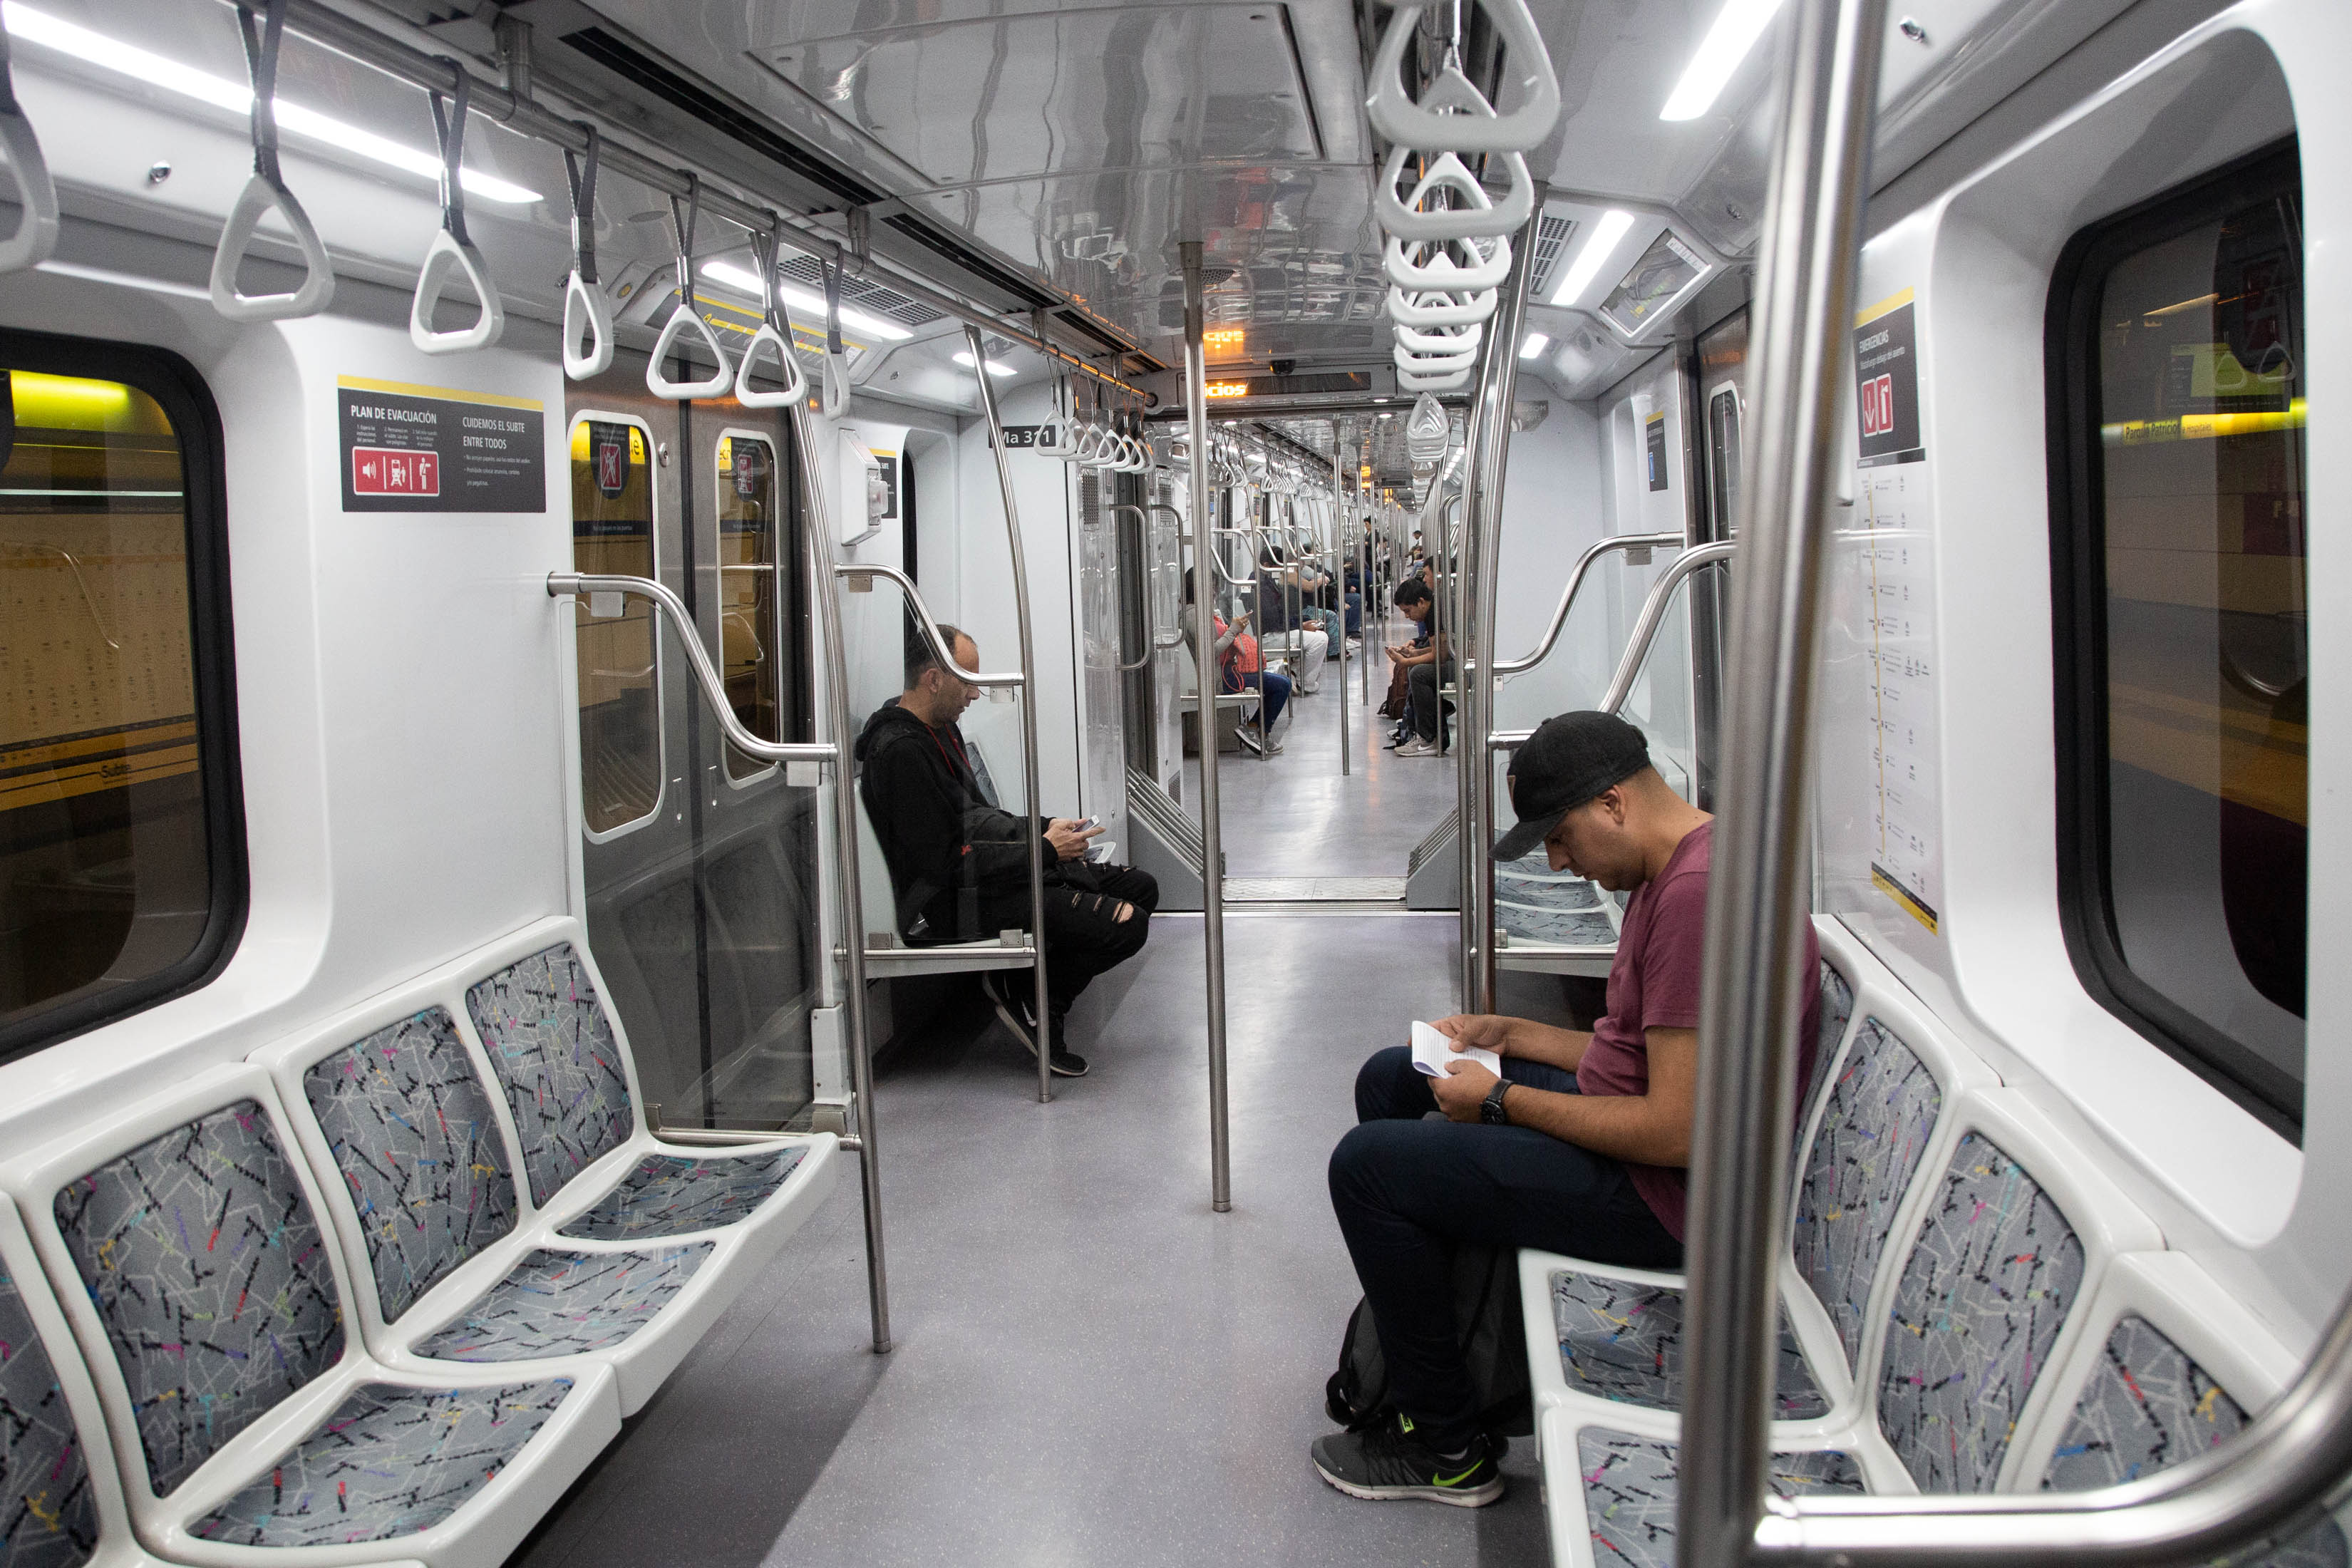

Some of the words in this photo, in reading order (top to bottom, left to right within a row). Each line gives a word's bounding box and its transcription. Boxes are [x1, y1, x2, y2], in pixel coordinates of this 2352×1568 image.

[351, 405, 373, 418] PLAN
[375, 407, 386, 419] DE
[387, 408, 437, 424] EVACUACIÓN
[463, 417, 497, 430] CUIDEMOS
[498, 421, 505, 431] EL
[506, 421, 525, 433] SUBTE
[463, 435, 483, 448] ENTRE
[485, 438, 507, 450] TODOS
